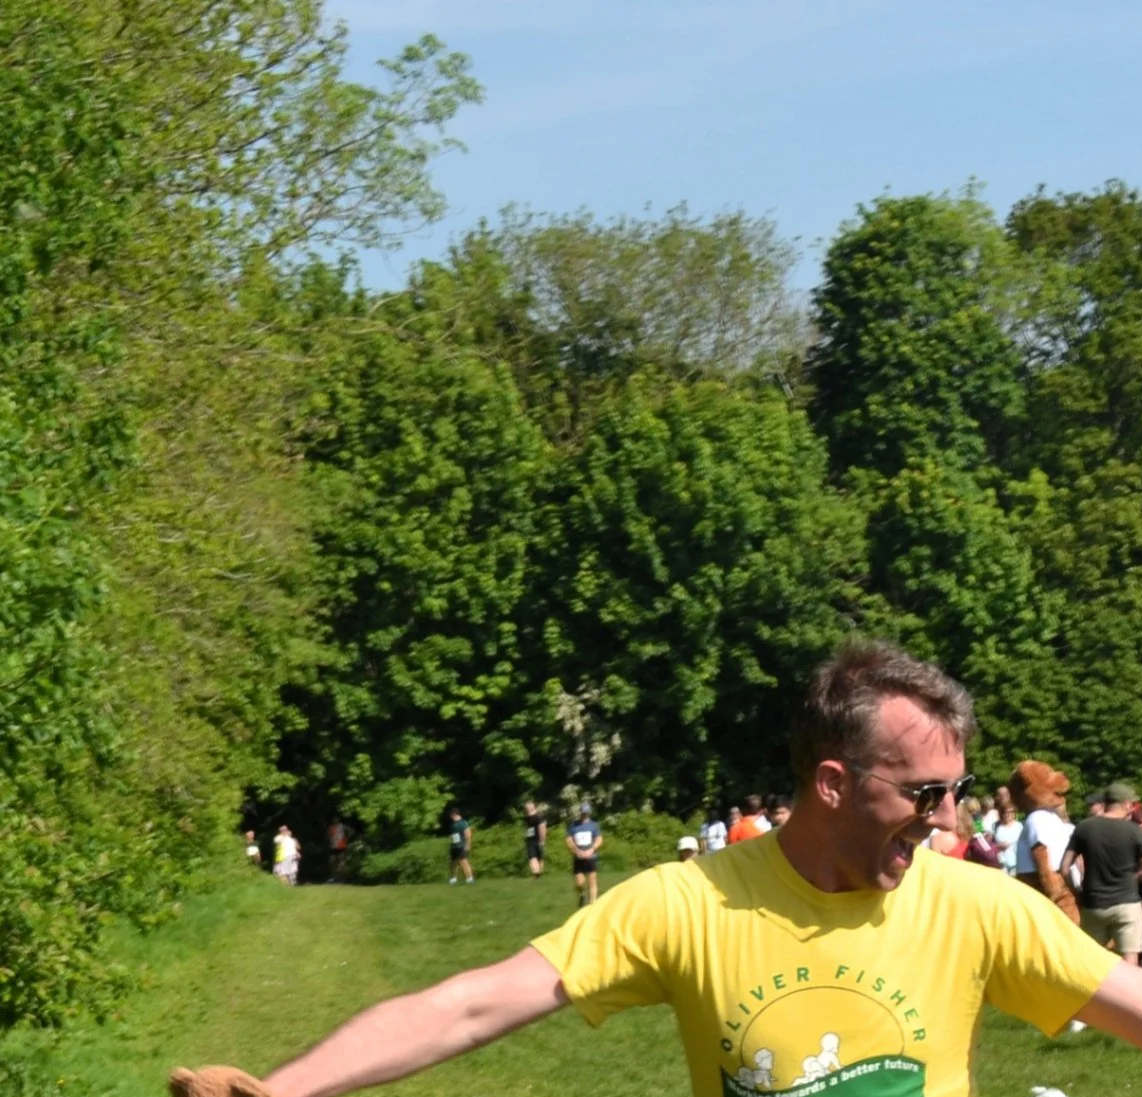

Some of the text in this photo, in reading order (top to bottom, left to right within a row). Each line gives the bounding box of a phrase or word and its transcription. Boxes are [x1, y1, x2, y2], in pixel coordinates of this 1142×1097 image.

[720, 964, 927, 1053] OLIVER FISHER
[829, 1076, 838, 1087] a
[841, 1062, 881, 1082] better
[884, 1059, 920, 1073] future
